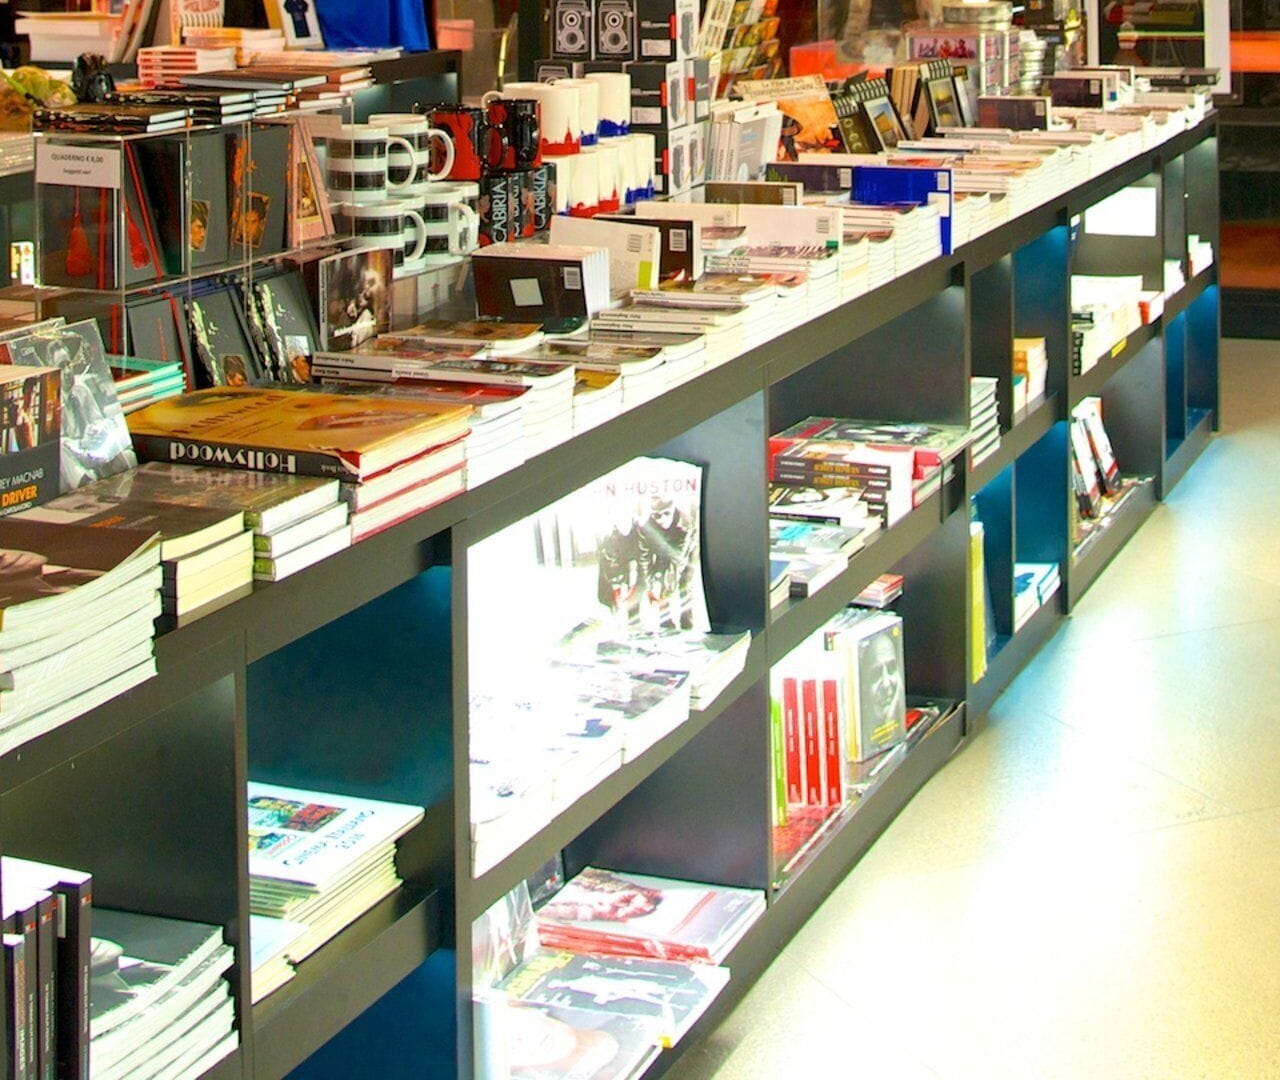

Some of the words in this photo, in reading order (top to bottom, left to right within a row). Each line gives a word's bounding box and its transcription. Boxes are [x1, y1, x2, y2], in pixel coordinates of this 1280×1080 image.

[491, 179, 507, 245] CABIRIA
[169, 441, 296, 473] Hollywood
[2, 485, 37, 508] DRIVER
[625, 478, 697, 495] HUSTON
